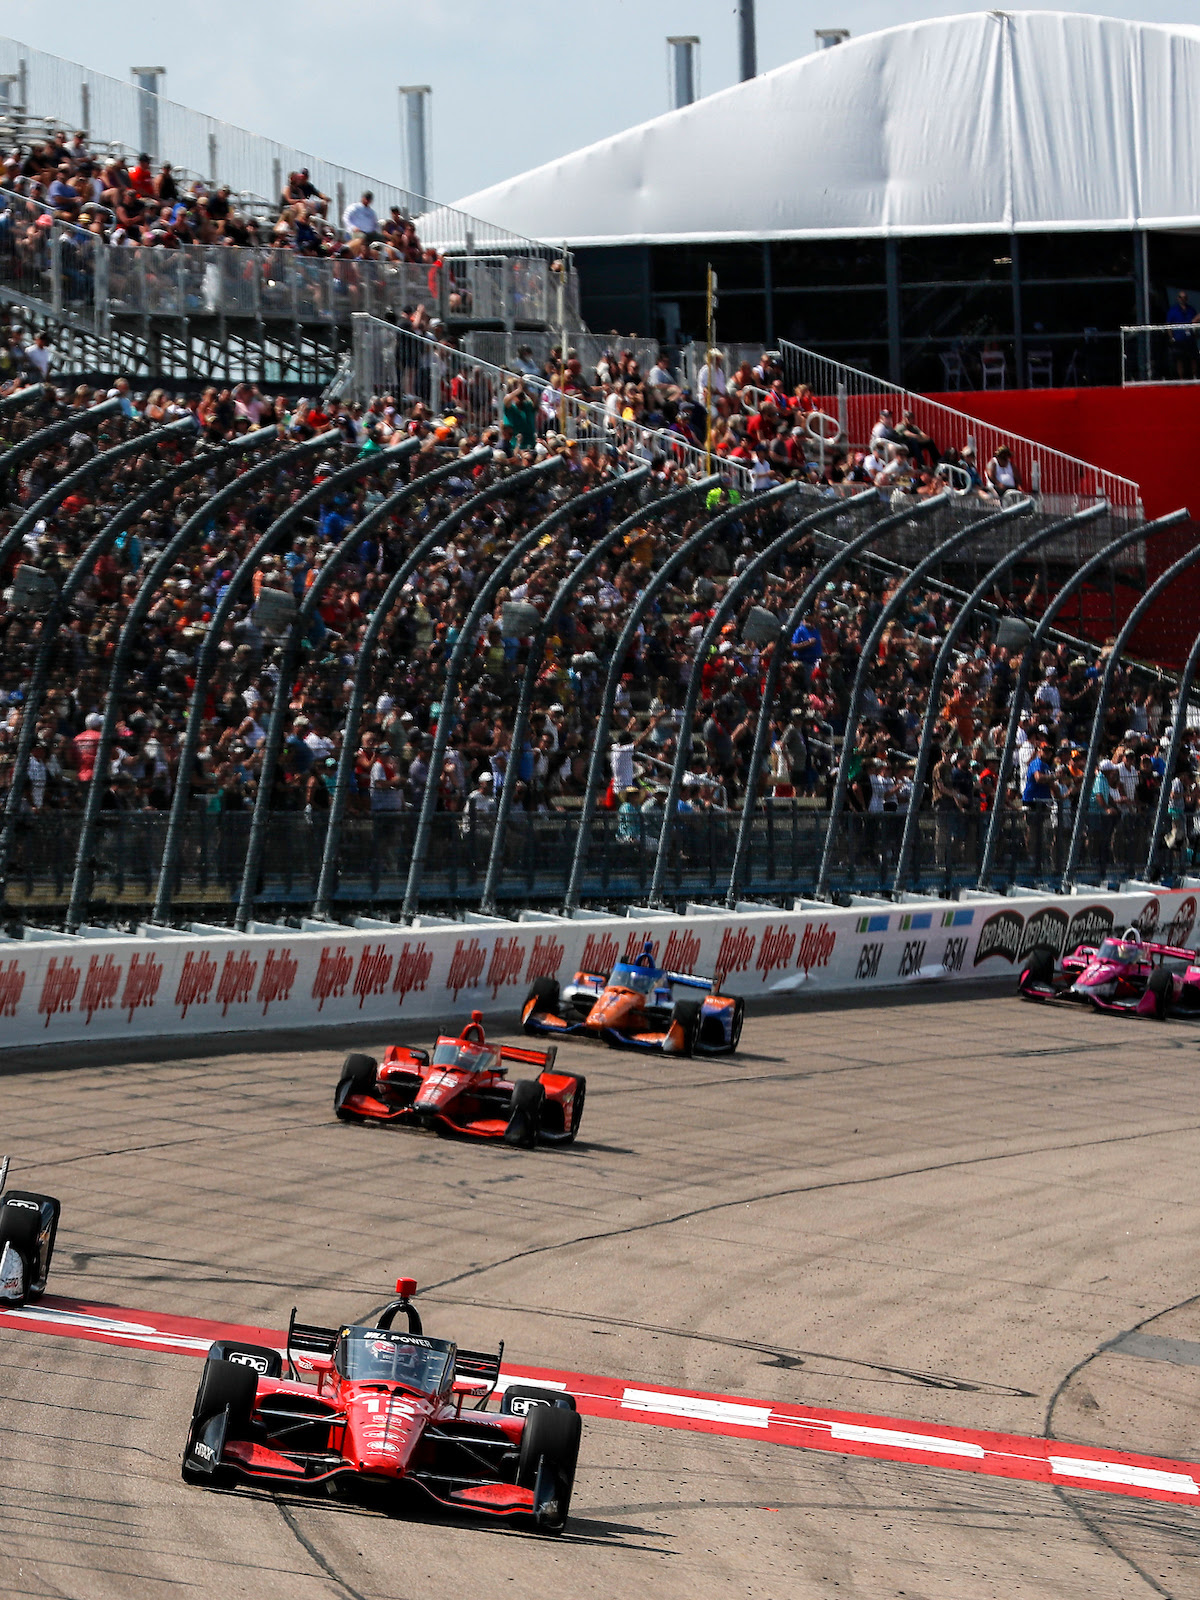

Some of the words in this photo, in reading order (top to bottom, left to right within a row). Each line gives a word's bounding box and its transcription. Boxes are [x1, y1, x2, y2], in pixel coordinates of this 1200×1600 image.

[855, 943, 884, 979] RSM
[898, 940, 927, 976] RSM
[942, 937, 969, 971] RSM
[390, 1335, 434, 1348] POWER
[362, 1399, 415, 1422] 12
